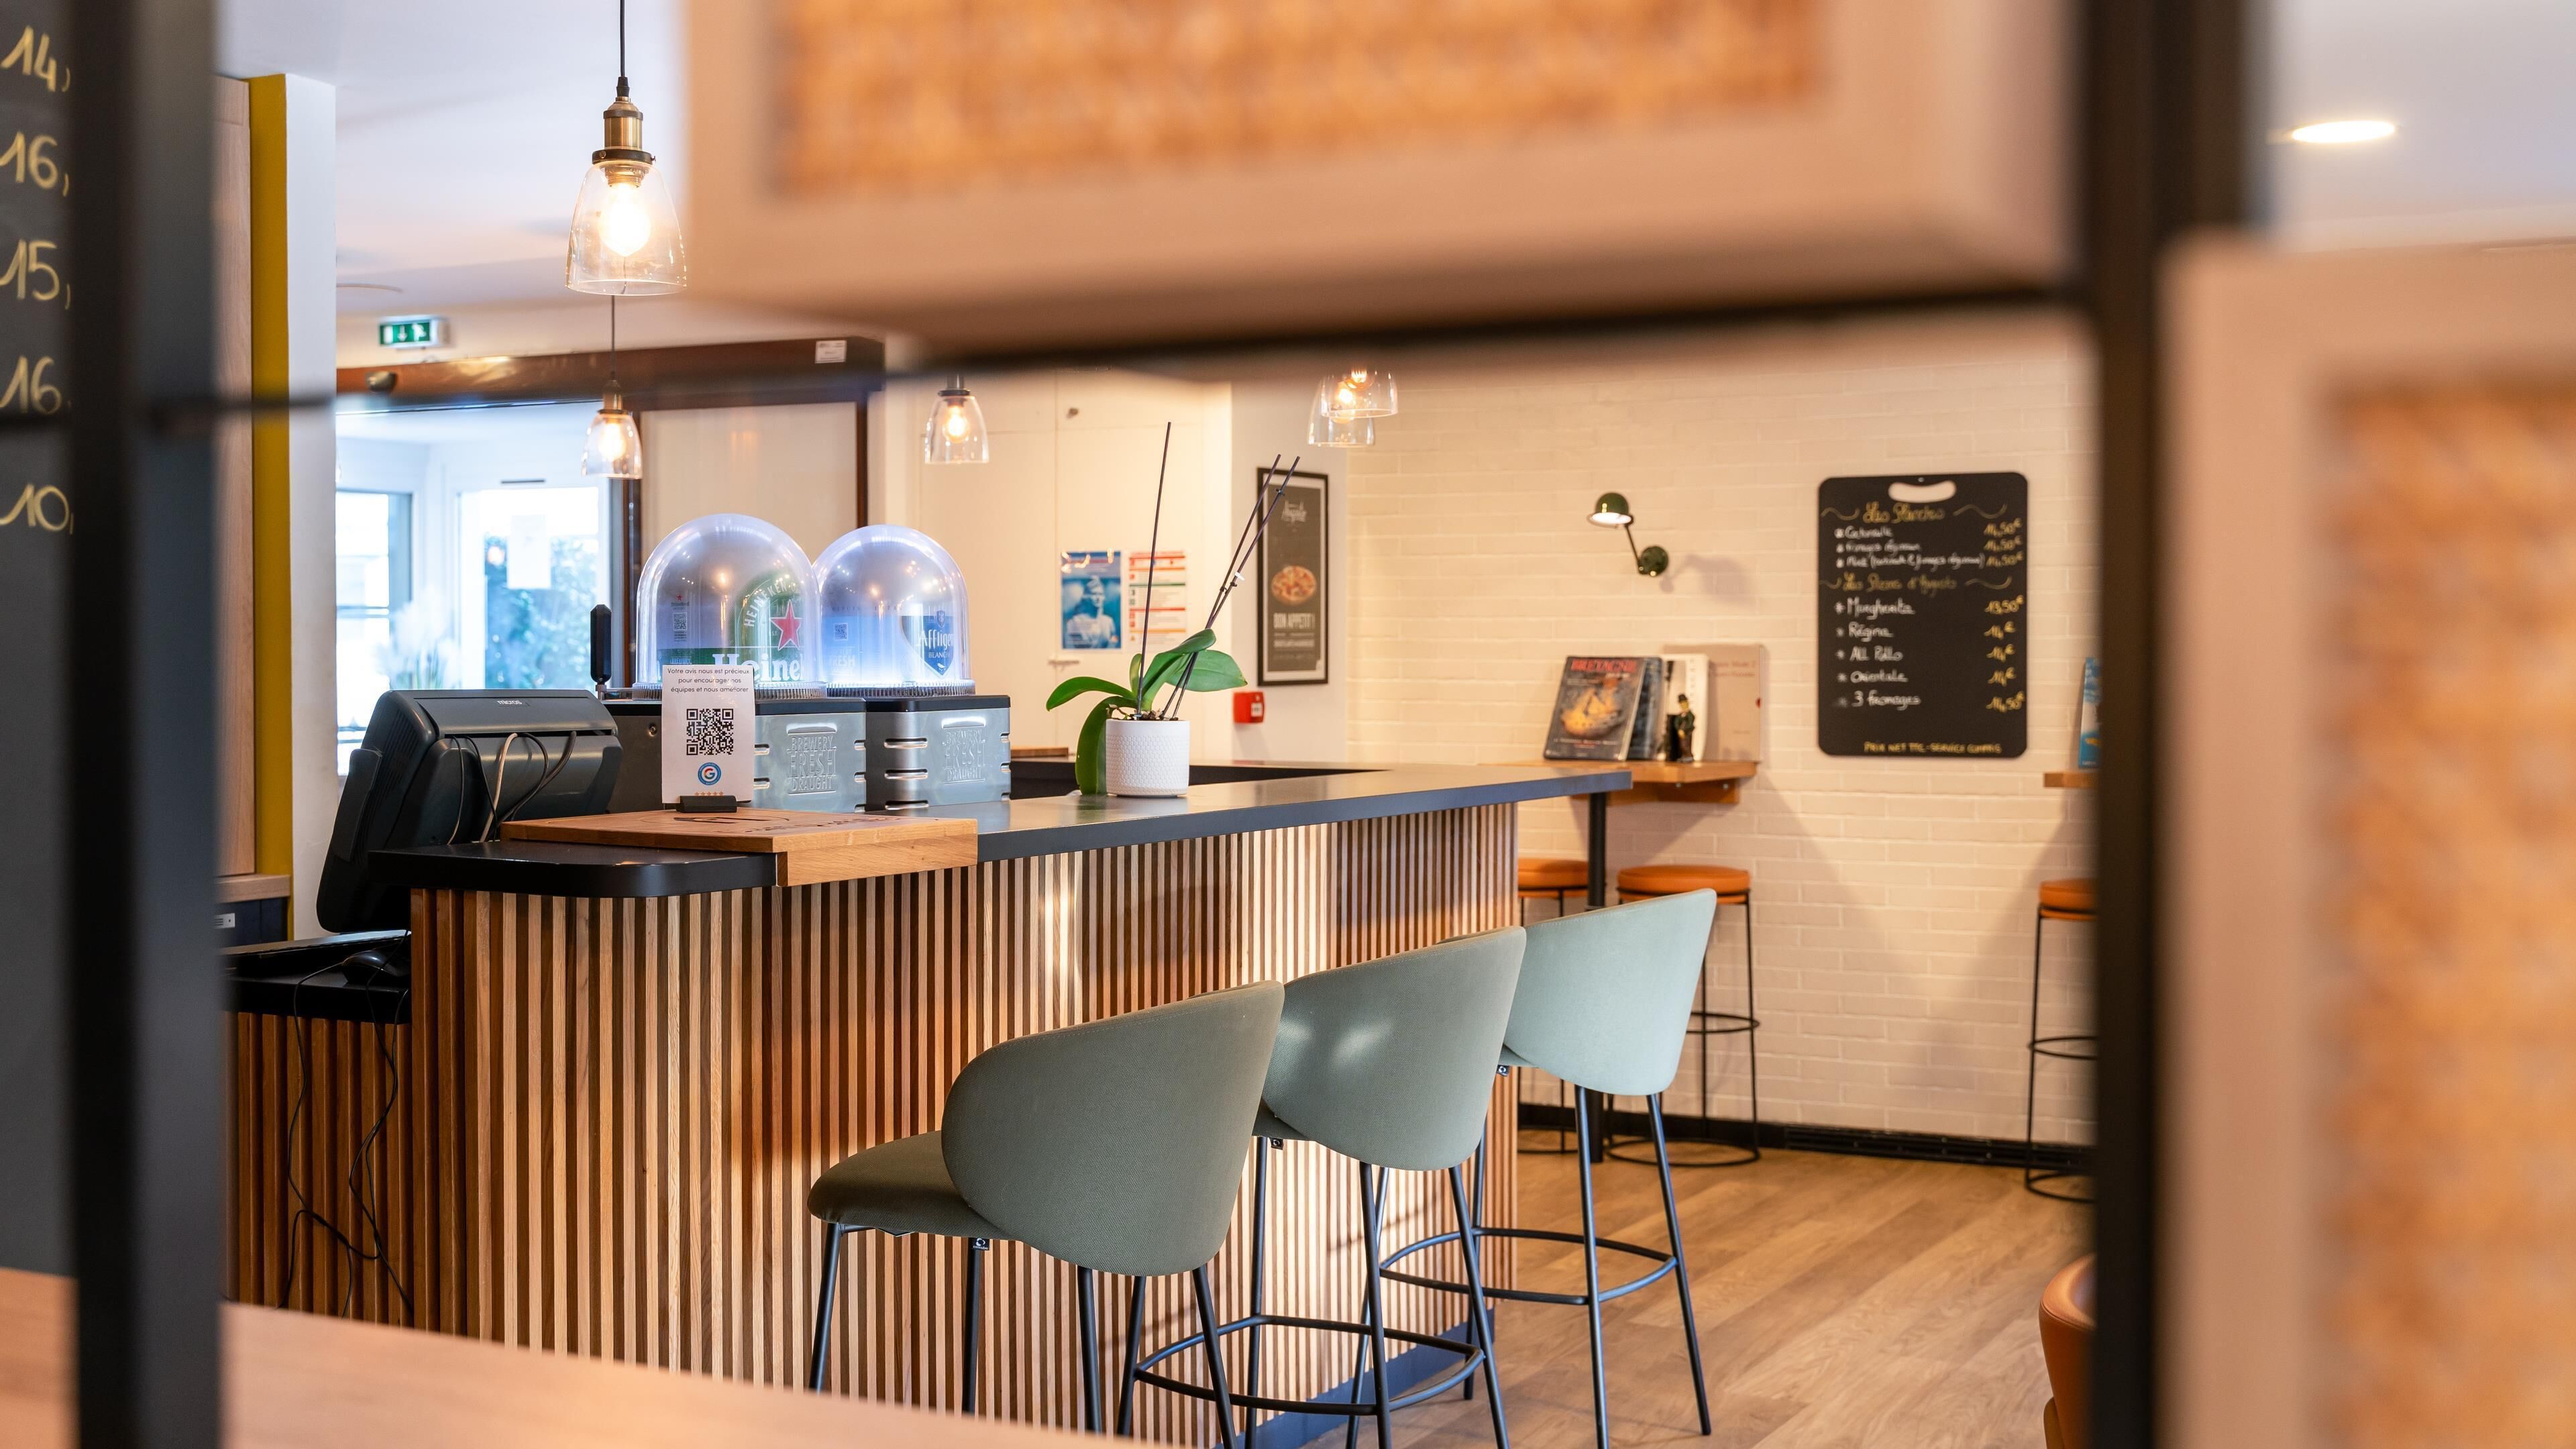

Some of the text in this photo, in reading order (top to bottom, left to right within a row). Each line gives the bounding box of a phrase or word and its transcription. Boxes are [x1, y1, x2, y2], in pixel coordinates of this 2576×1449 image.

[743, 579, 788, 627] HEINEKEN
[916, 629, 955, 651] Afflige
[1570, 659, 1638, 673] BRETAGNE
[1851, 690, 1864, 707] 3
[792, 735, 834, 751] BREWERY
[790, 751, 837, 777] FRESH
[792, 777, 833, 791] DRAUGHT
